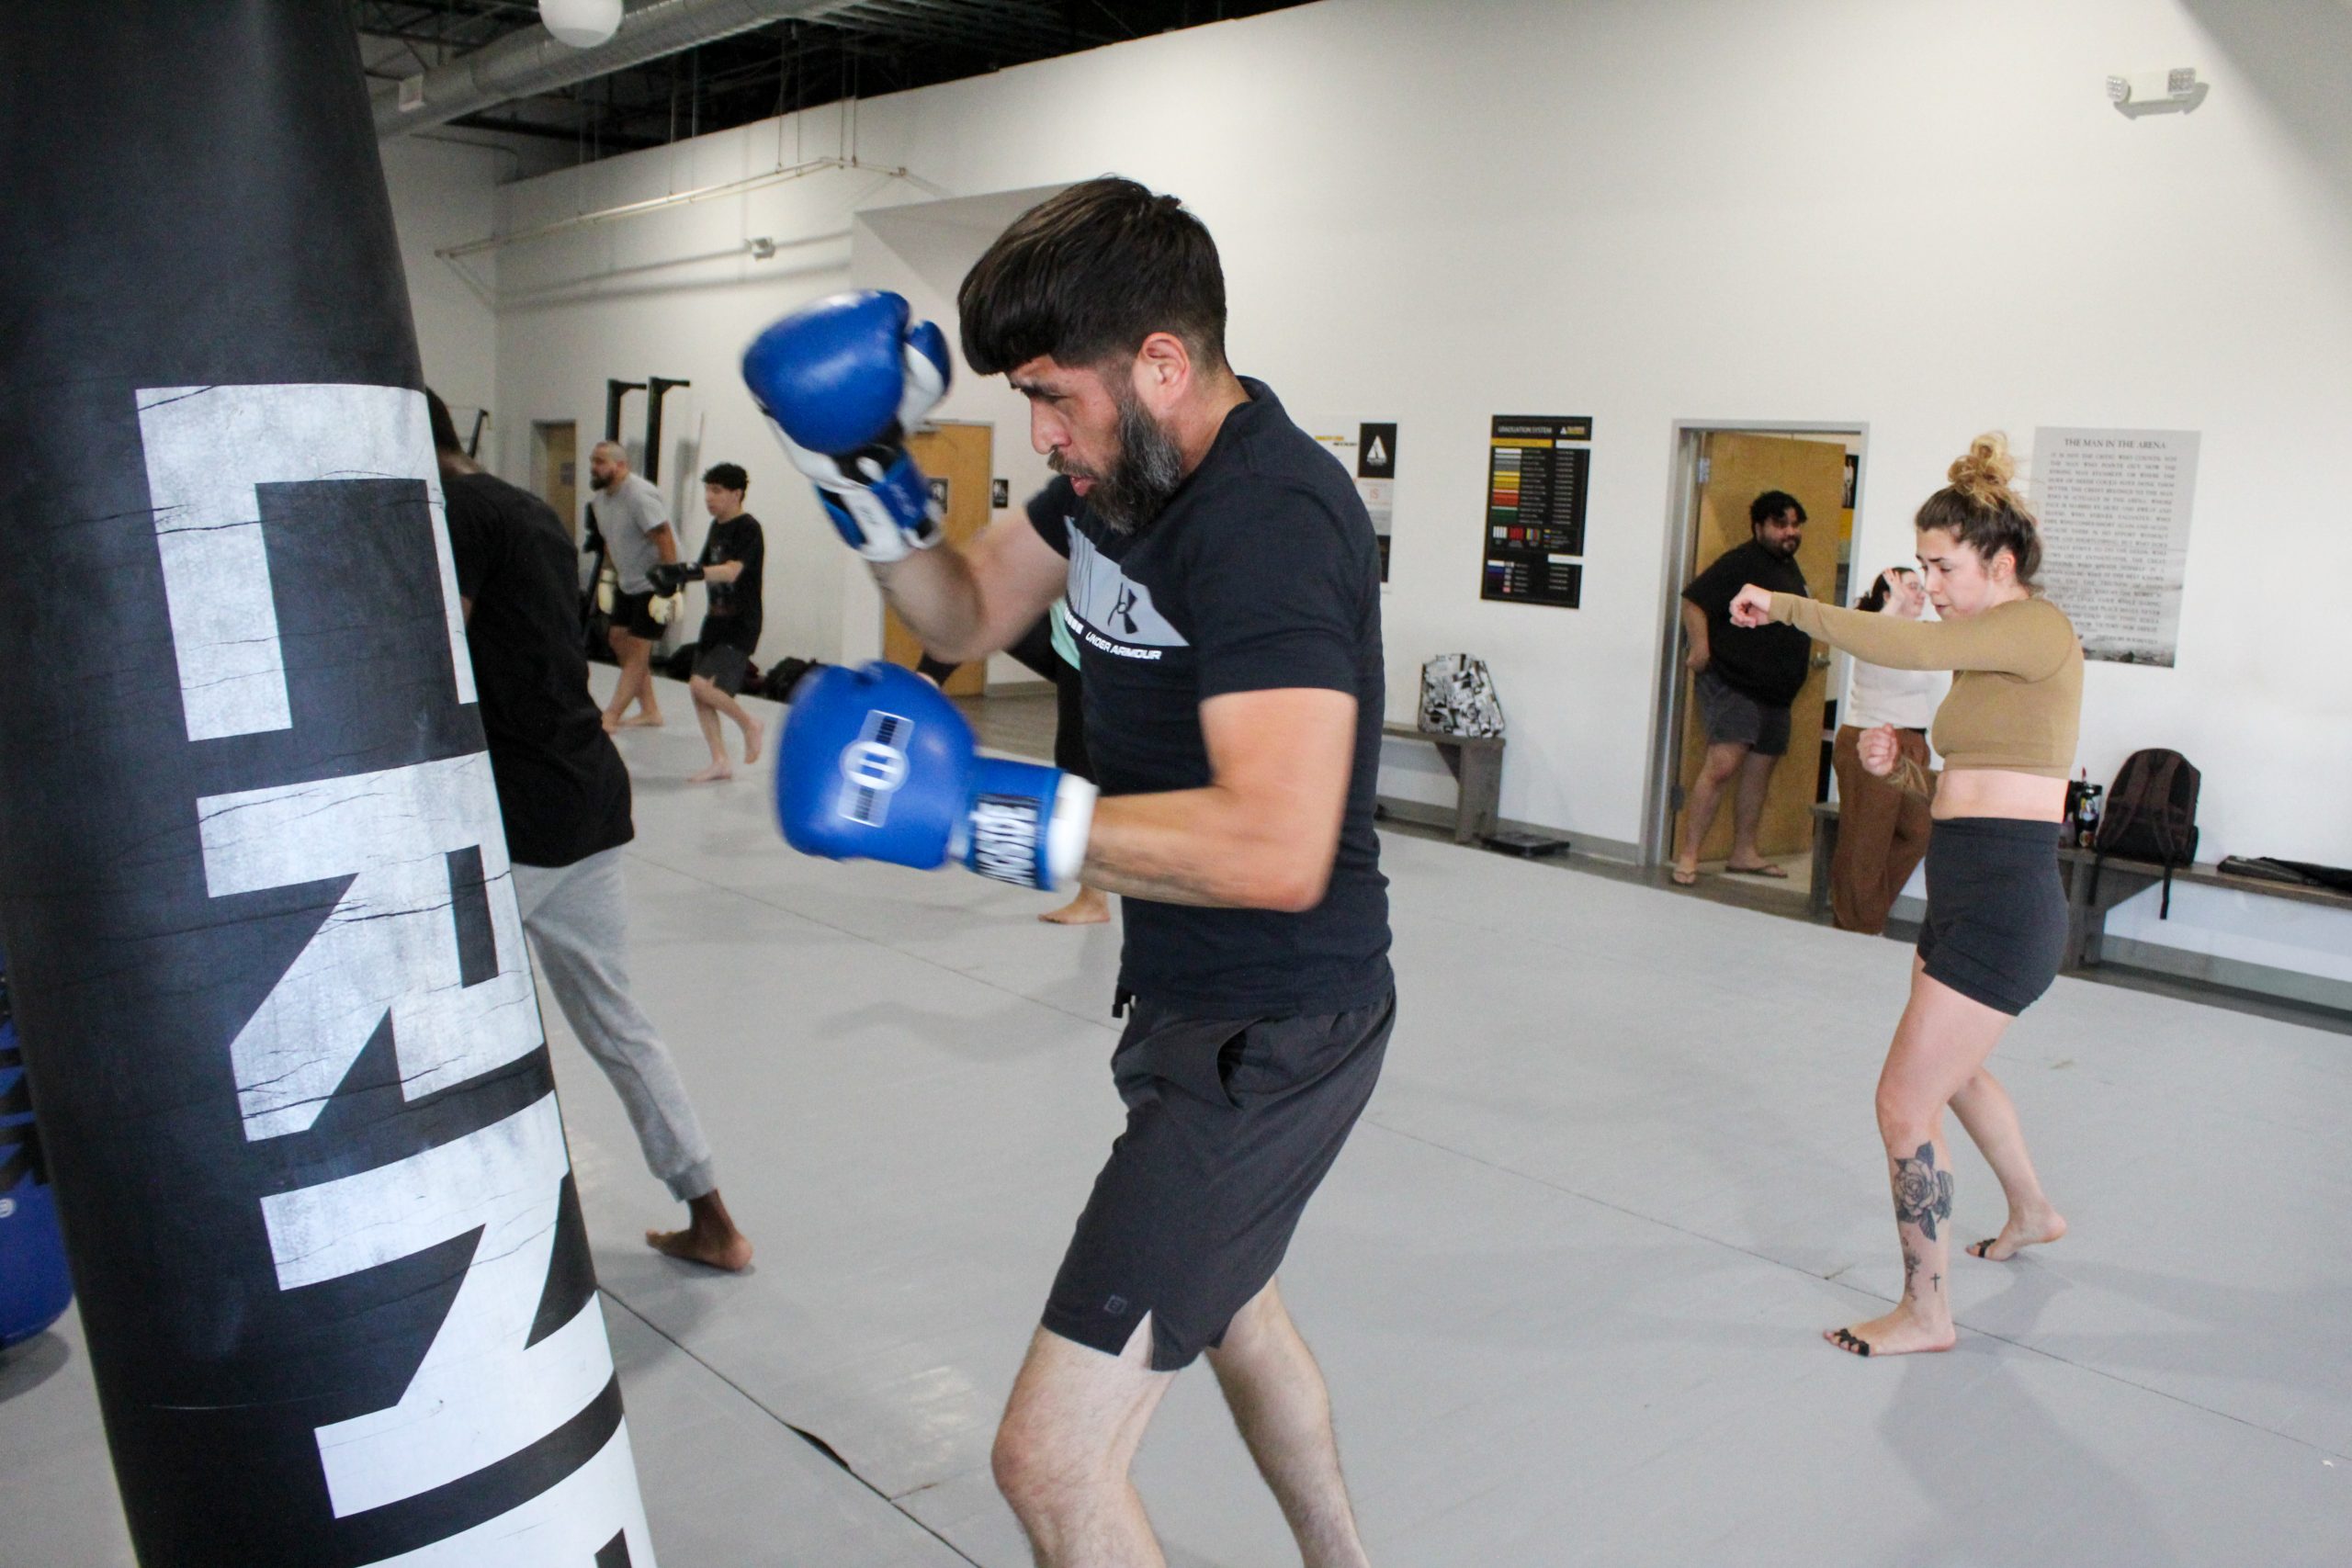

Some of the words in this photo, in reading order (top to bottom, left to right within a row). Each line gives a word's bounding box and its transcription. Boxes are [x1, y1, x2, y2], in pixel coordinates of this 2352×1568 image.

[1532, 426, 1552, 434] SYSTEM
[2064, 438, 2080, 447] THE
[2083, 438, 2103, 447] MAN
[2105, 439, 2115, 448] IN
[2117, 439, 2133, 448] THE
[2137, 440, 2166, 449] ARENA
[1085, 631, 1112, 652] UNDER
[1111, 645, 1162, 660] ARMOUR
